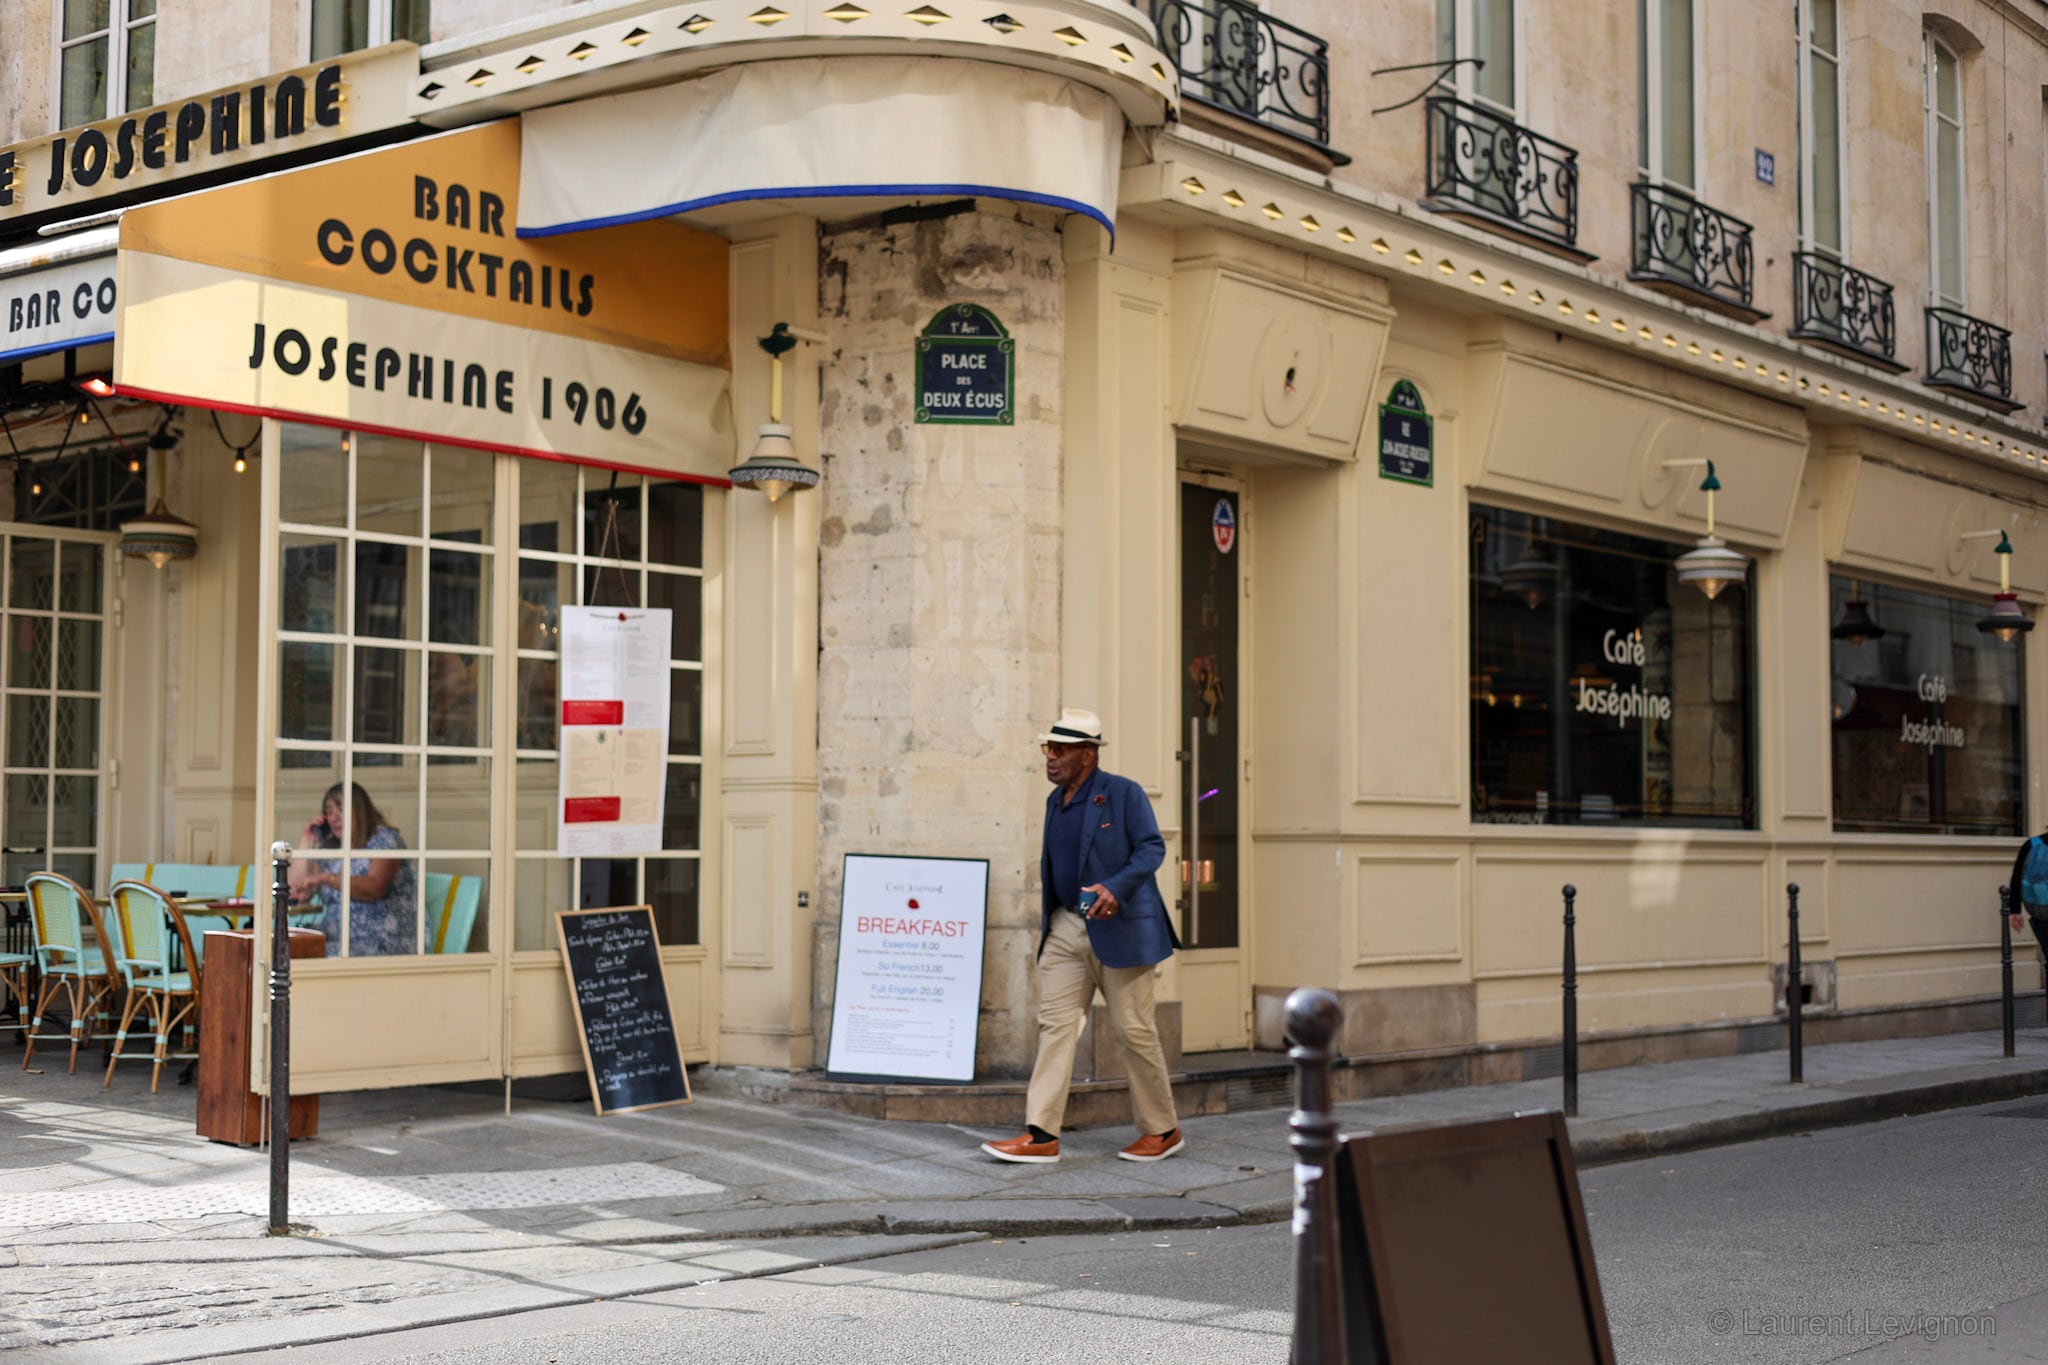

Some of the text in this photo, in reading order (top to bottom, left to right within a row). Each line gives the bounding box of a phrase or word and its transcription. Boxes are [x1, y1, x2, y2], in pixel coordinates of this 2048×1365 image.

[48, 65, 342, 195] JOSEPHINE
[415, 175, 505, 236] BAR
[317, 218, 594, 317] COCKTAILS
[9, 289, 60, 333] BAR
[249, 323, 647, 435] JOSEPHINE 1906
[941, 353, 987, 369] PLACE
[956, 376, 972, 385] DES
[924, 390, 1004, 408] DEUX ÉCUS
[1603, 629, 1645, 667] Café
[1576, 677, 1671, 728] Joséphine
[1917, 673, 1947, 704] Café
[1900, 713, 1964, 755] Joséphine
[857, 917, 969, 938] BREAKFAST
